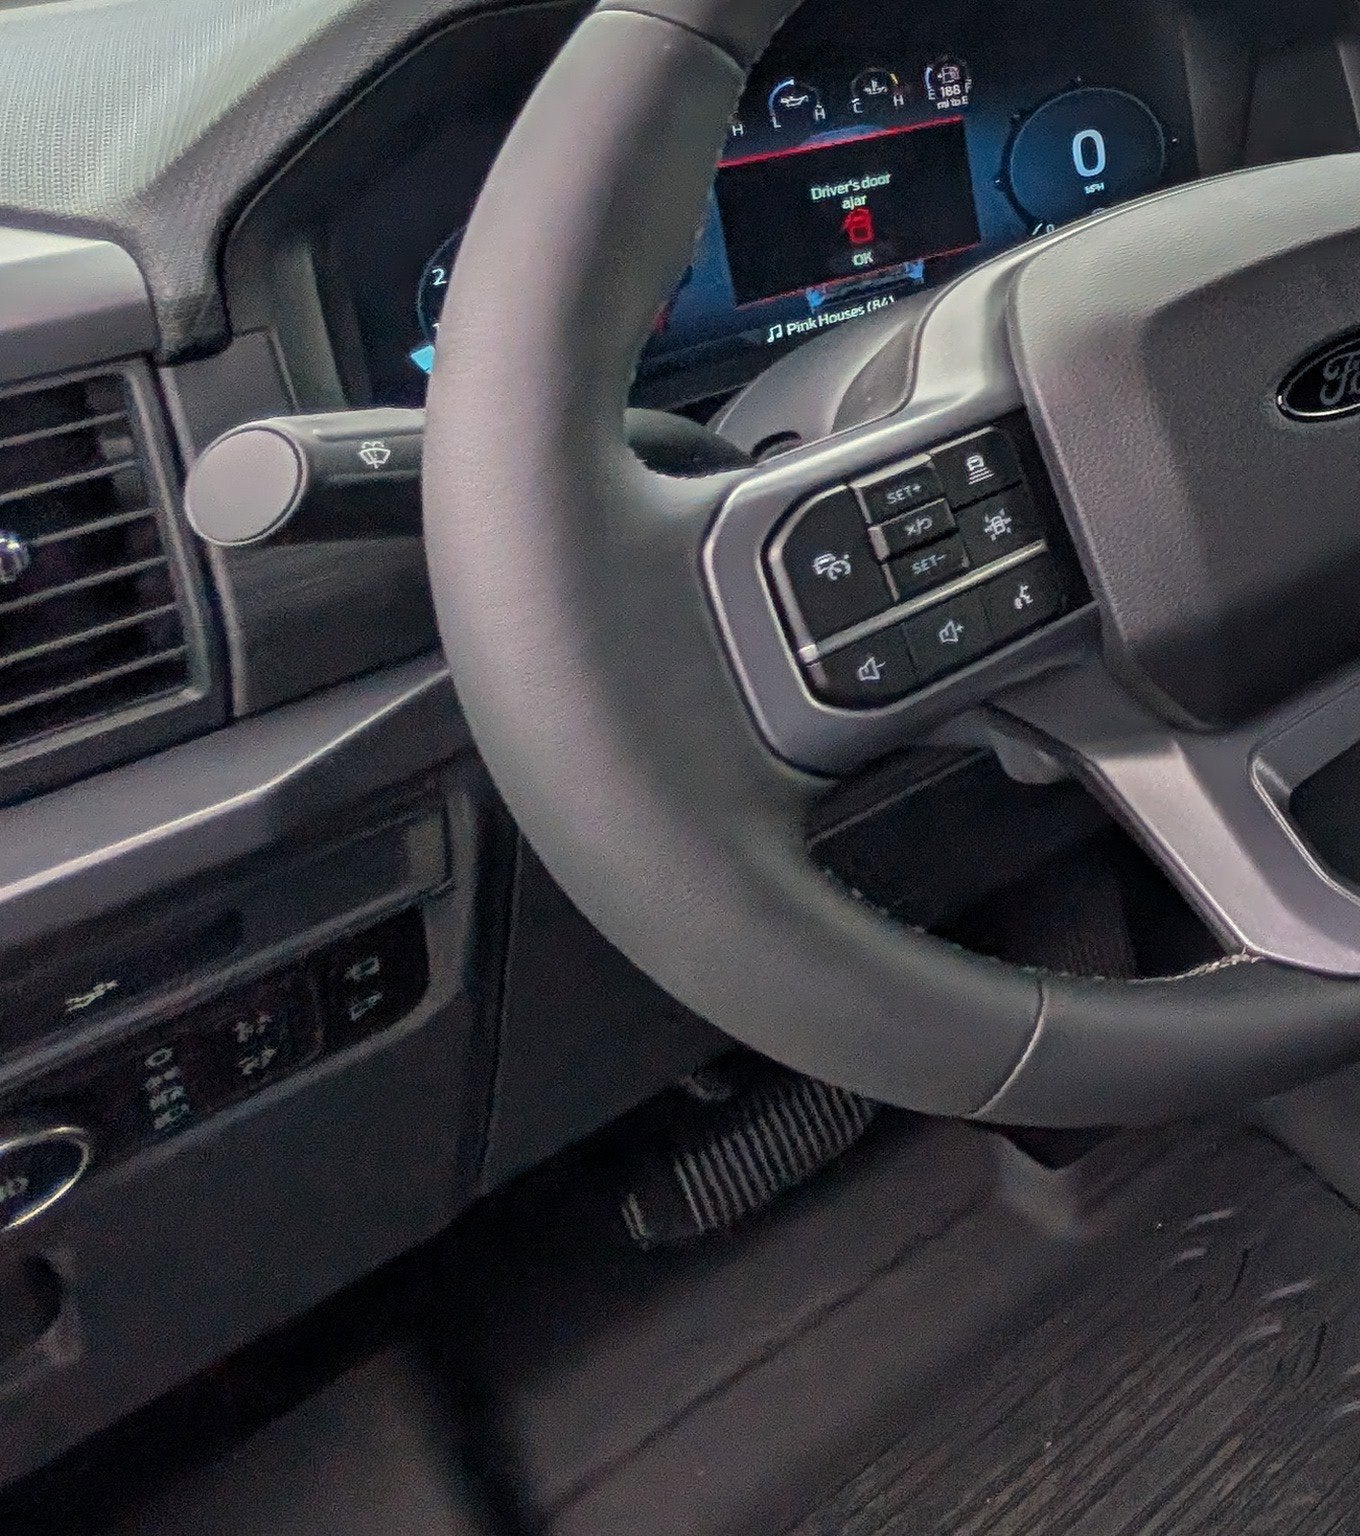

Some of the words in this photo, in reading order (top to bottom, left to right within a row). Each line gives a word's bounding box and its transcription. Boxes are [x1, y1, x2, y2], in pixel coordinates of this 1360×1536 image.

[940, 84, 961, 98] 188
[731, 124, 744, 137] H
[1073, 129, 1105, 177] 0
[810, 180, 860, 201] Driver's
[861, 172, 891, 189] door
[841, 193, 868, 211] ajar
[852, 251, 874, 266] OK
[431, 268, 447, 285] 2
[786, 317, 818, 336] Pink
[818, 305, 865, 327] Houses
